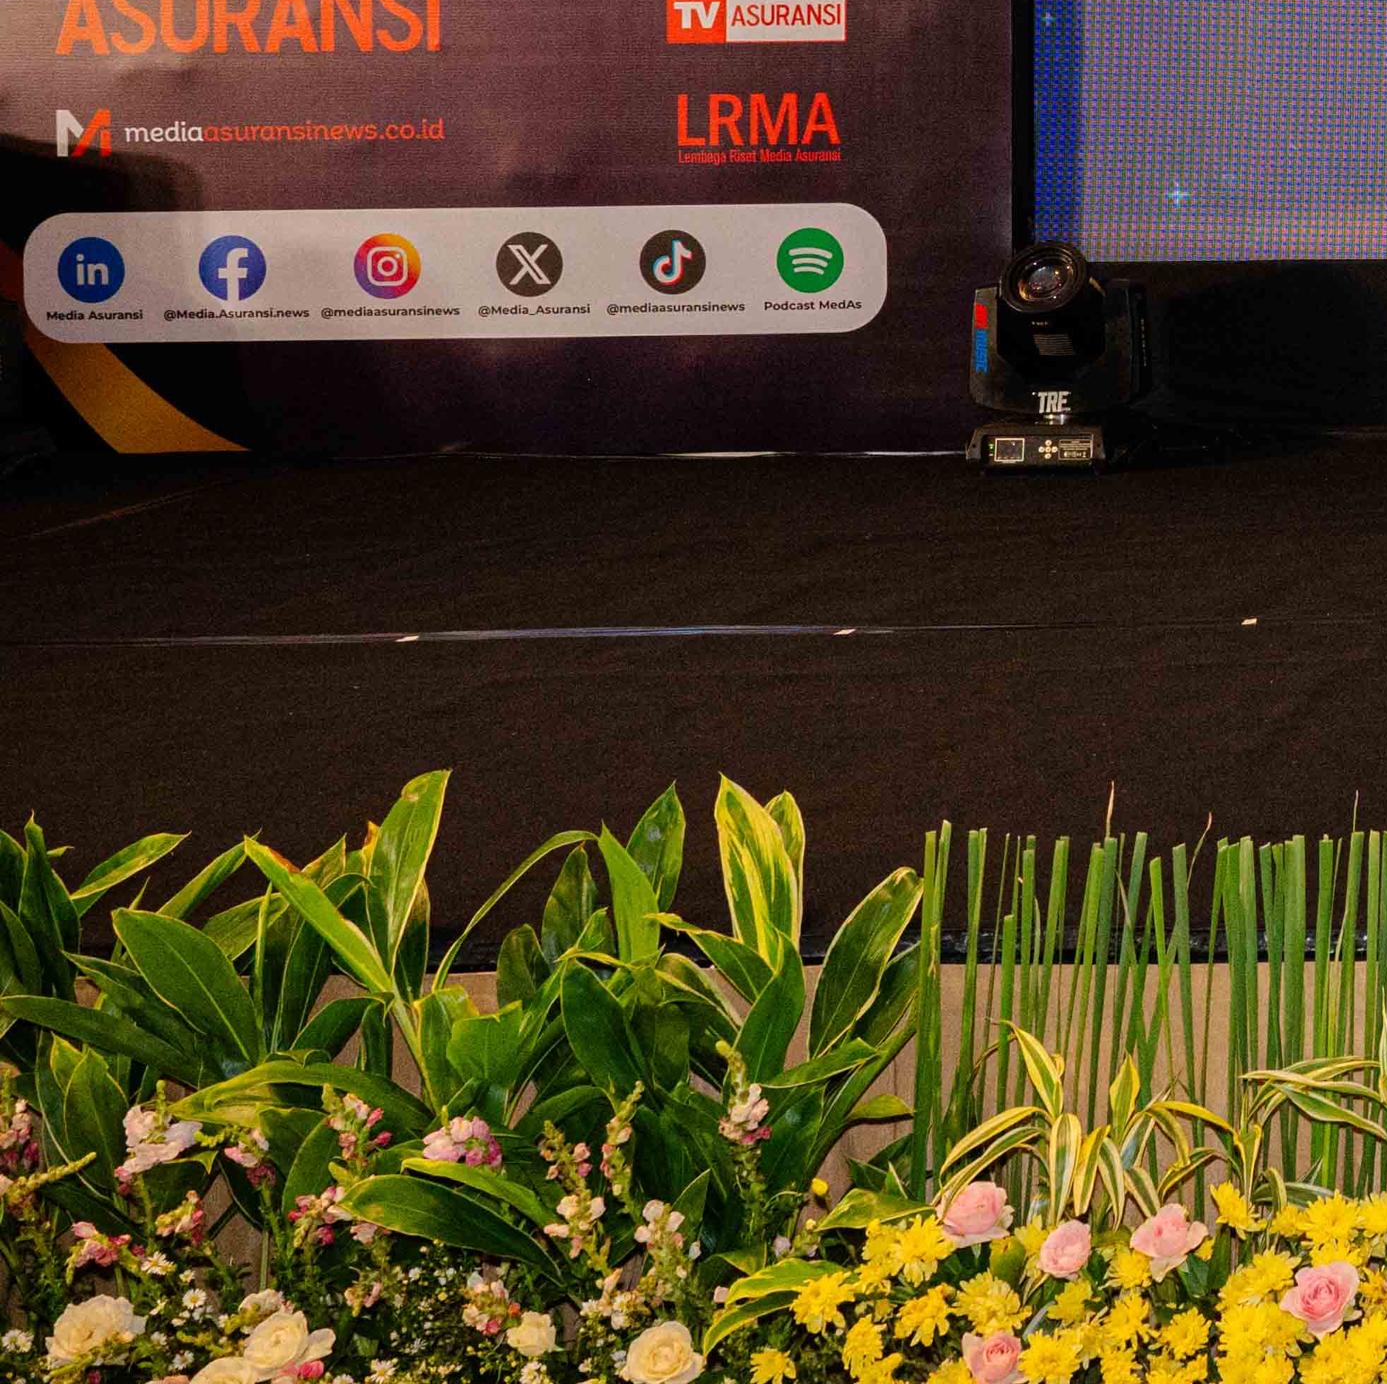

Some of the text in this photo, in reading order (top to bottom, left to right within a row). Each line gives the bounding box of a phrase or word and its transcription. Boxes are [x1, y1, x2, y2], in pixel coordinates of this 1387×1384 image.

[673, 1, 842, 29] TV ASURANSI
[677, 92, 842, 147] LRMA
[124, 118, 445, 144] mediaasuransinews.co.id
[320, 305, 461, 319] @mediaasuransinews
[477, 303, 591, 317] @Media_Asuransi
[606, 301, 746, 315] @mediaasuransinews
[764, 299, 863, 312] Podcast MedAs
[46, 309, 144, 322] Media Asuransi
[163, 307, 310, 321] @Media.Asuransi.news
